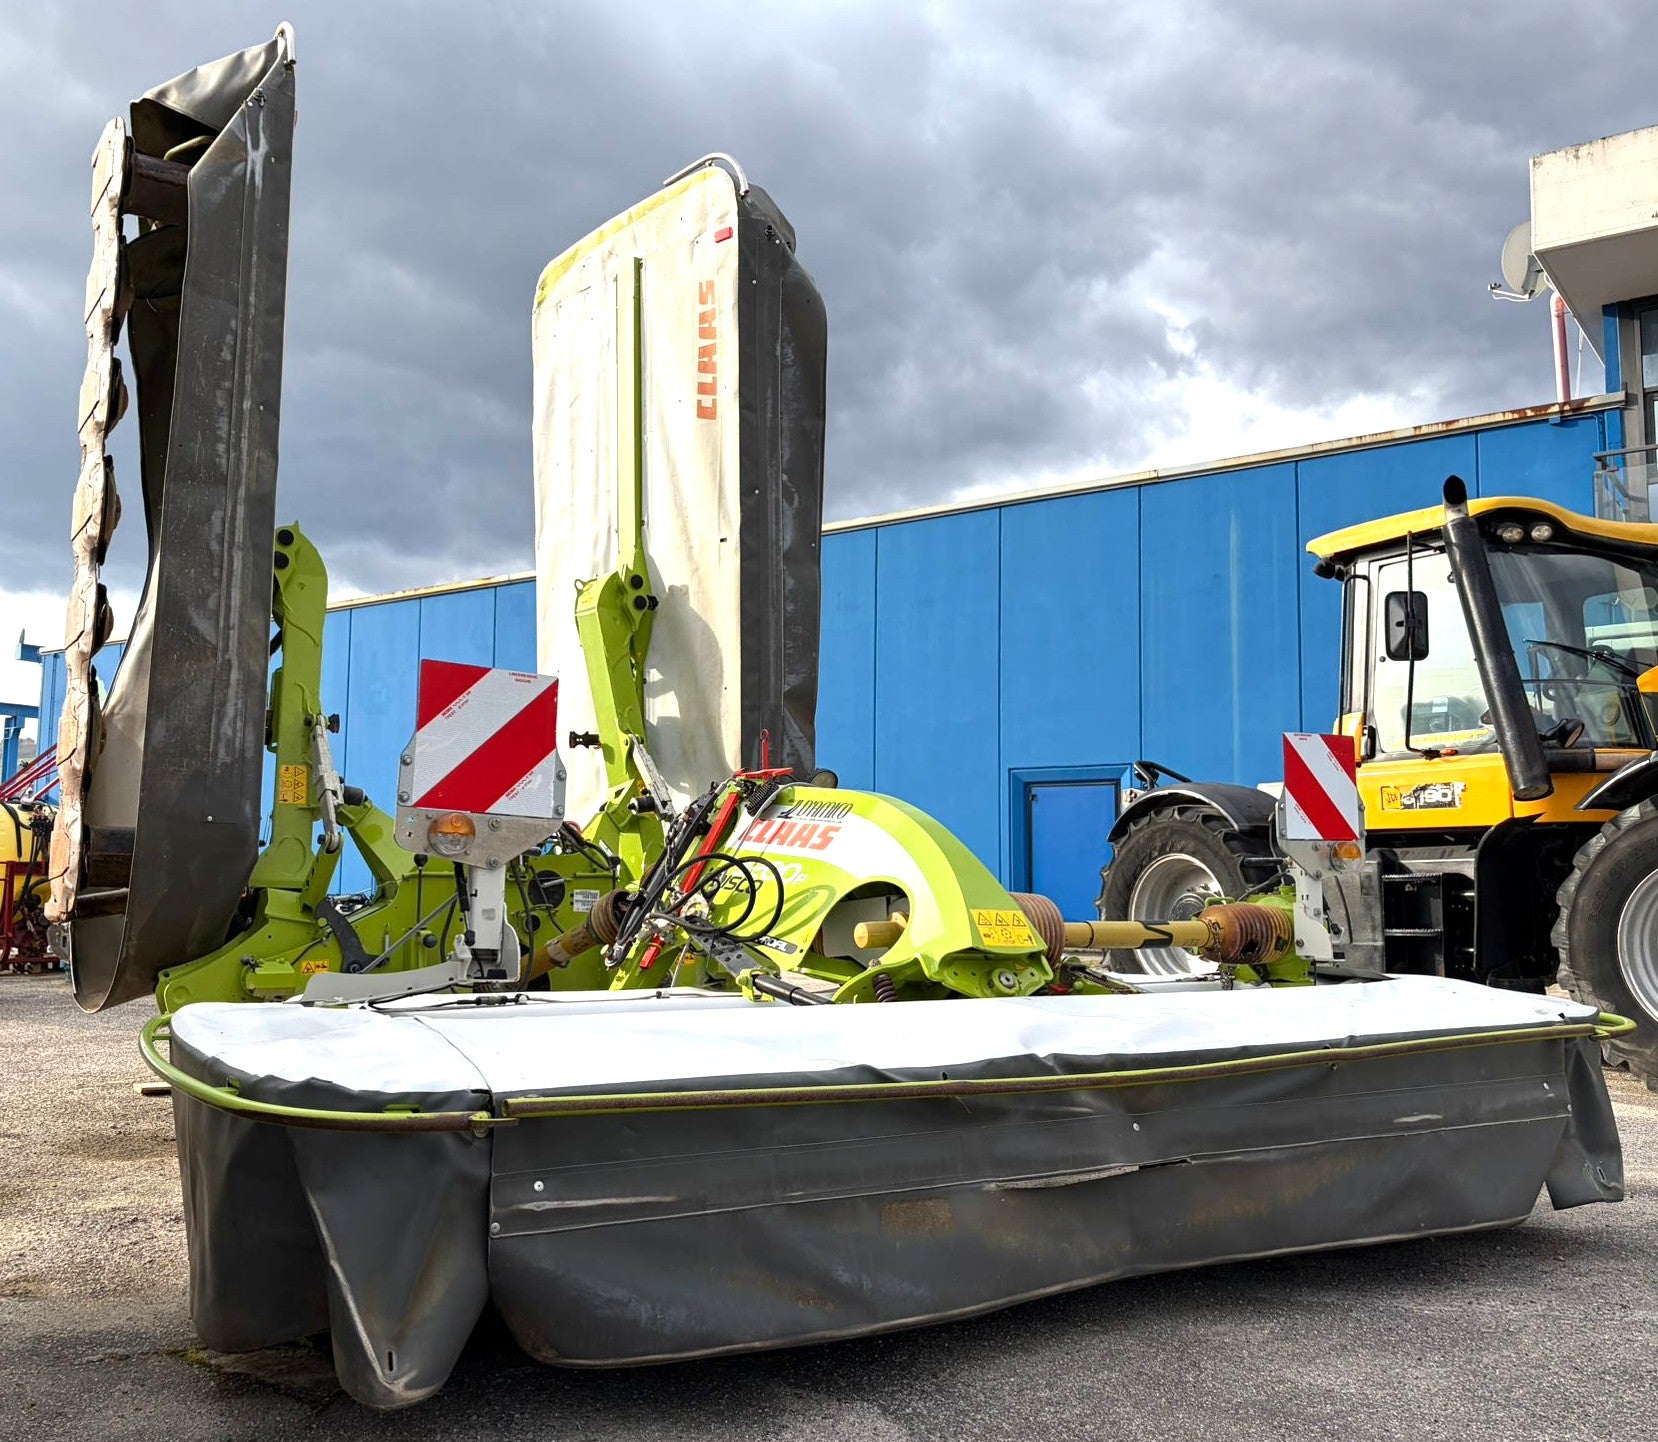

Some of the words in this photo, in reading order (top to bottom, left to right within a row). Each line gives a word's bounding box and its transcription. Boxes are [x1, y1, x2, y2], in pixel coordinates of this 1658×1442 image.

[697, 280, 717, 420] CLAAS
[738, 818, 842, 851] CLAAS
[717, 873, 763, 893] ISCO
